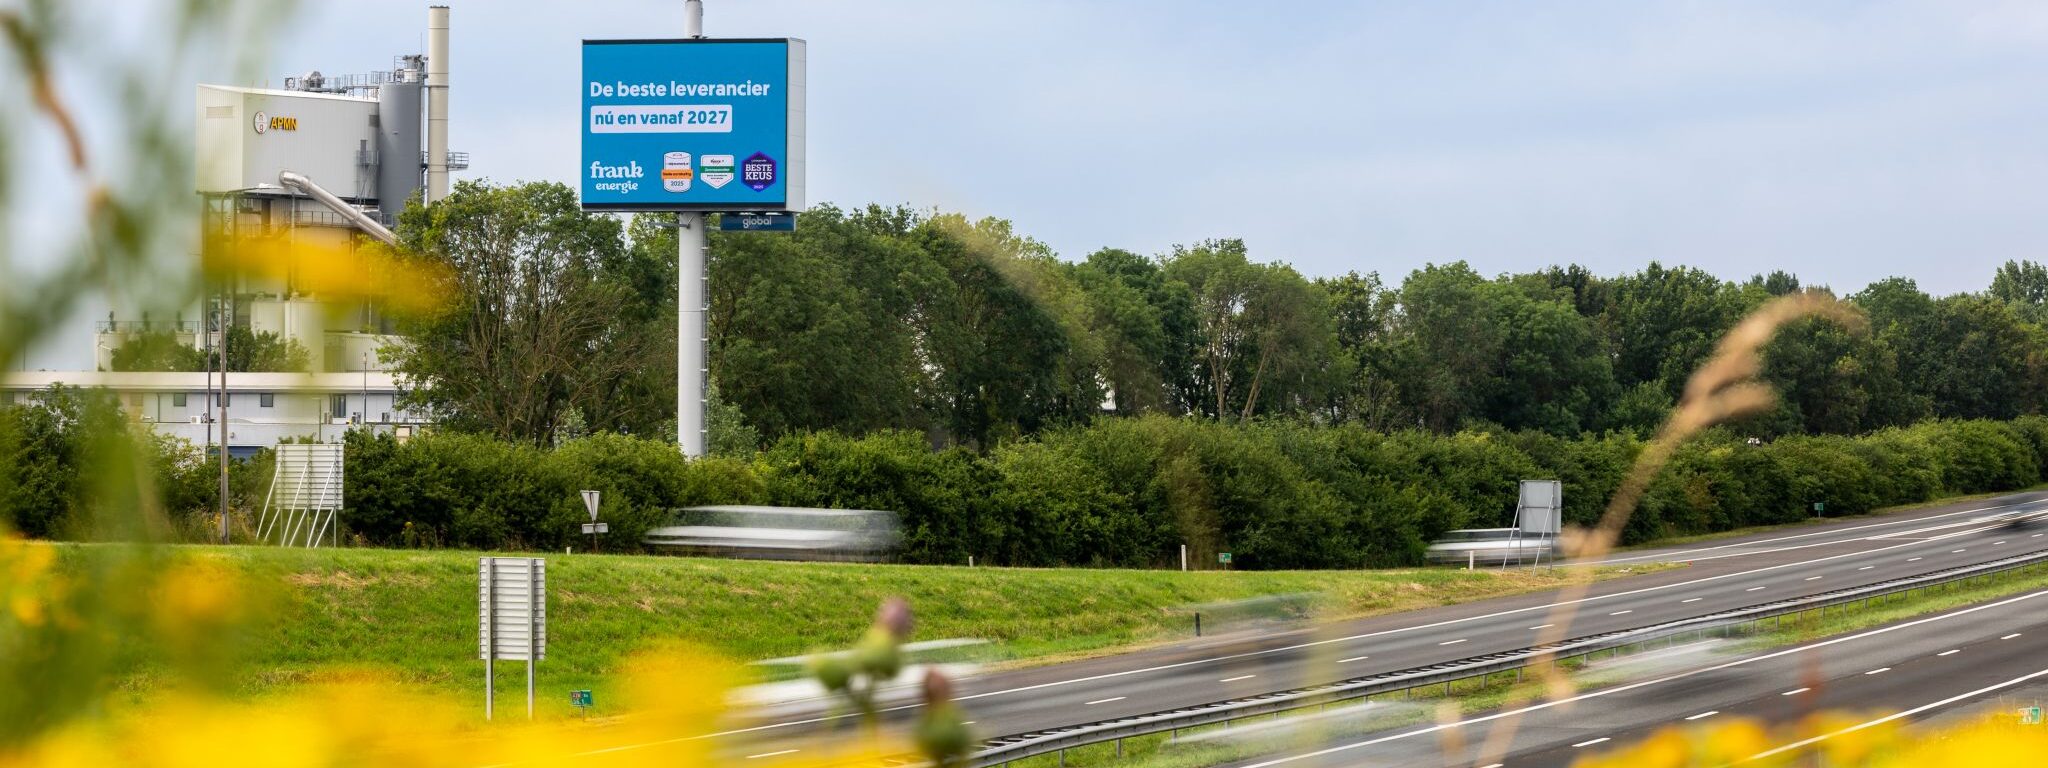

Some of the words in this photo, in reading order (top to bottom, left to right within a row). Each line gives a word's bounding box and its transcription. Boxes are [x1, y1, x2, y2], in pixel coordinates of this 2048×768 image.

[590, 82, 613, 97] De
[617, 81, 667, 97] beste
[670, 80, 770, 96] leverancier
[269, 116, 297, 131] APMN
[595, 111, 614, 125] nú
[617, 114, 637, 125] en
[640, 111, 684, 125] vanaf
[687, 111, 728, 124] 2027
[590, 160, 644, 179] frank
[745, 164, 773, 172] BESTE
[745, 172, 773, 180] KEUS
[595, 180, 639, 194] energie
[742, 215, 772, 229] global
